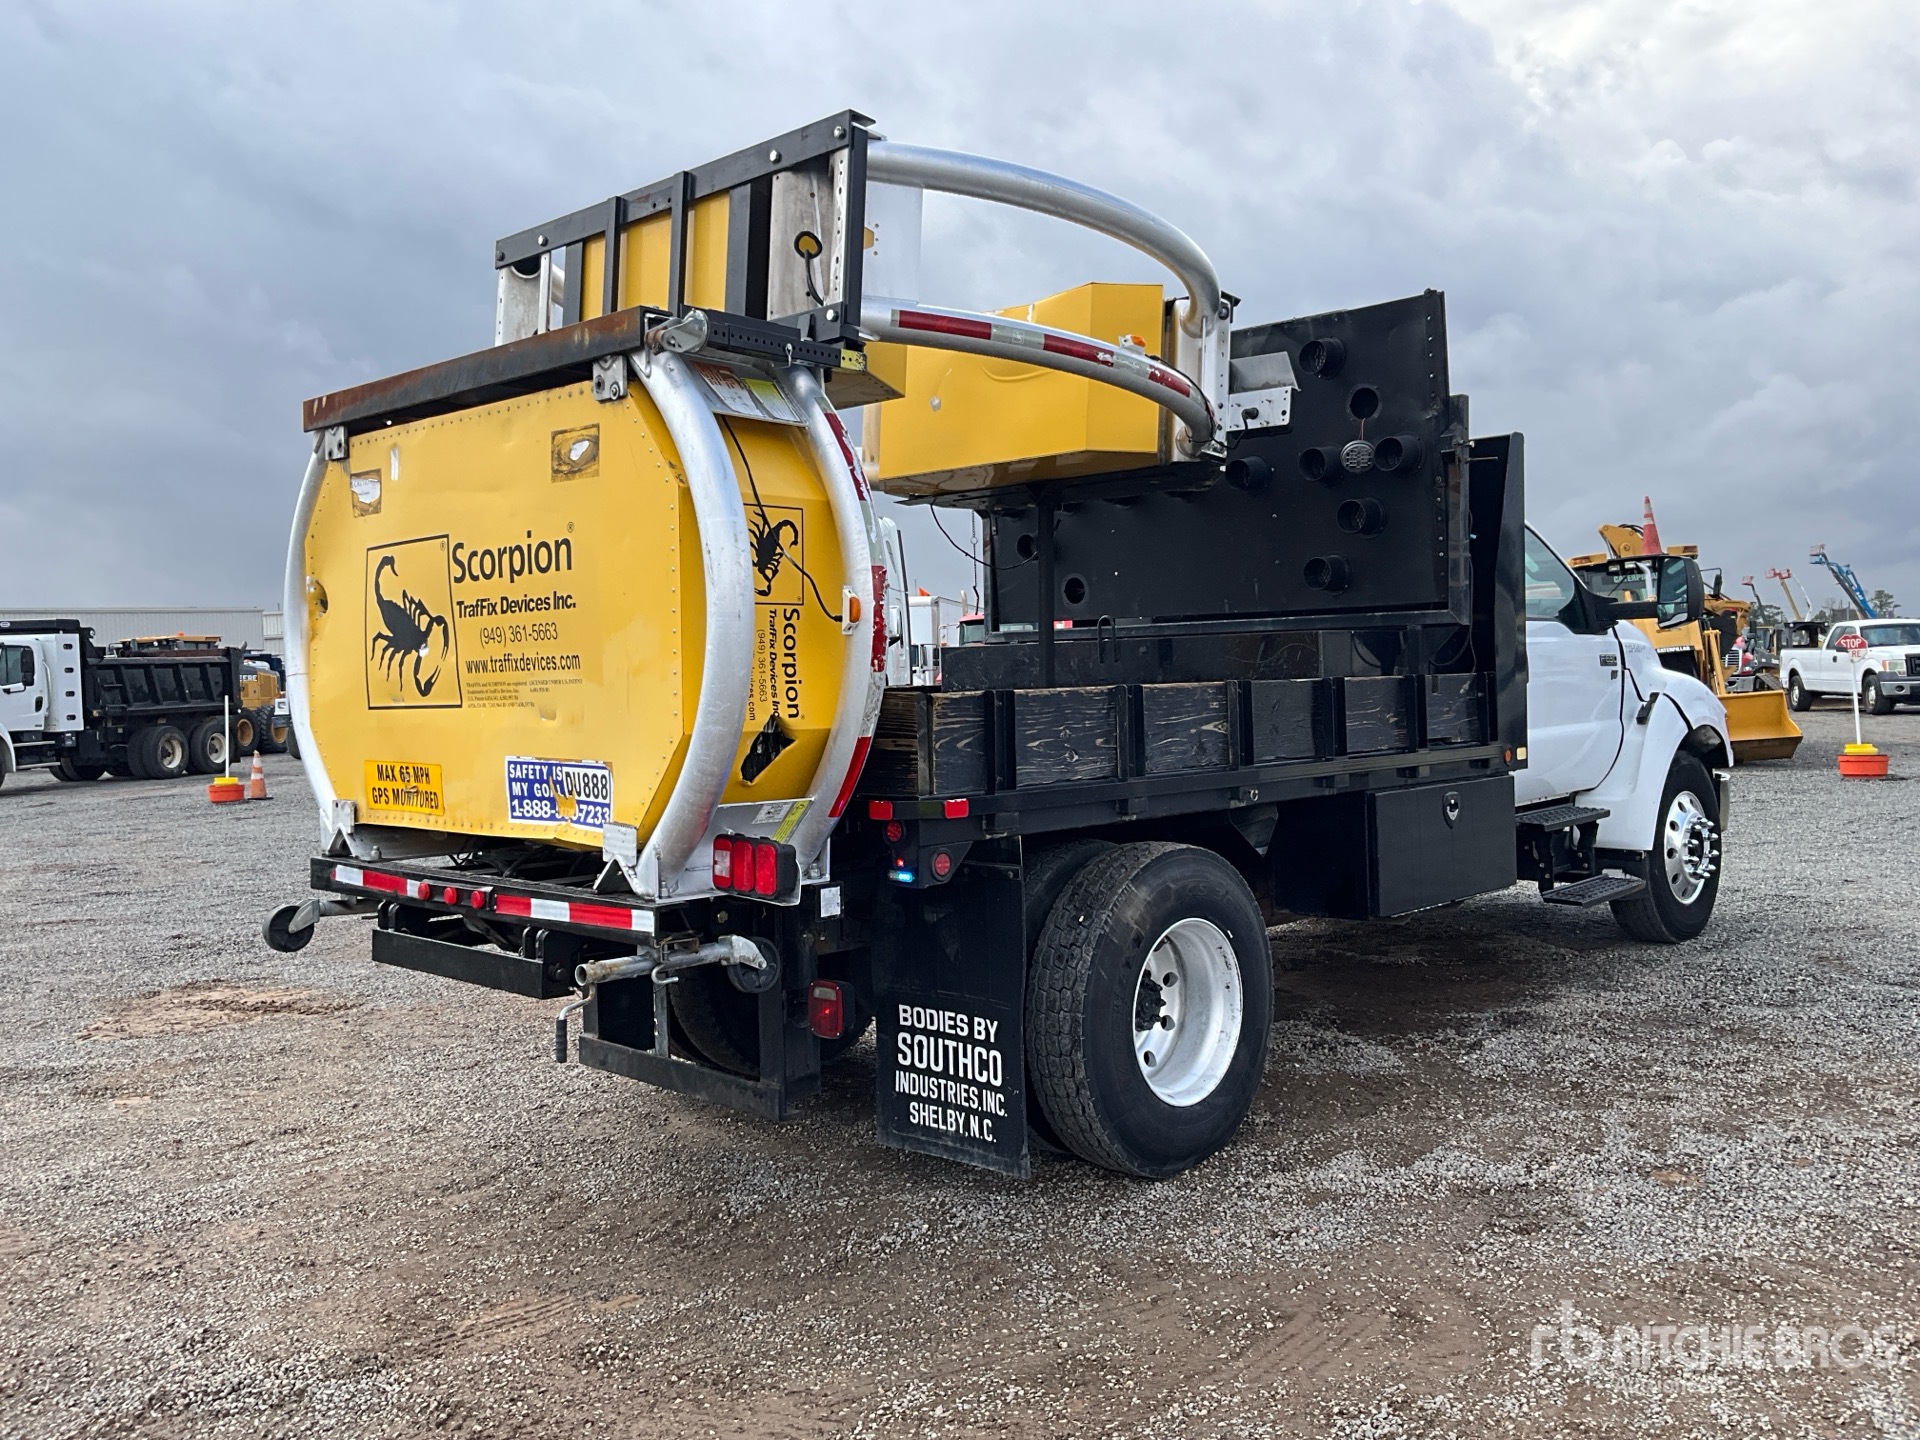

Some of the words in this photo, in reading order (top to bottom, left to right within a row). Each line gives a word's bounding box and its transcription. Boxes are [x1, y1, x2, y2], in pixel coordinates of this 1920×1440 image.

[452, 530, 572, 584] Scorpion
[457, 598, 498, 618] TrafFix
[500, 594, 551, 615] Devices
[553, 591, 576, 611] Inc.
[480, 626, 507, 649] (949)
[509, 622, 558, 643] 361-5663
[757, 629, 766, 654] (949)
[769, 609, 777, 649] TrafFix
[1840, 639, 1862, 649] STOP
[466, 652, 581, 674] www.traffixdevices.com
[769, 652, 778, 699] Devices
[781, 608, 802, 718] Scorpion
[758, 657, 767, 703] 361-5663
[377, 764, 397, 782] MAX
[399, 766, 410, 783] 65
[413, 766, 430, 785] MPH
[509, 764, 548, 780] SAFETY
[552, 766, 562, 780] IS
[372, 787, 389, 805] GPS
[392, 788, 439, 810] MONITORED
[512, 782, 528, 796] MY
[534, 783, 564, 798] GOL
[565, 771, 608, 801] DU888
[898, 1004, 969, 1037] BODIES
[973, 1016, 998, 1043] BY
[897, 1032, 1003, 1087] SOUTHCO
